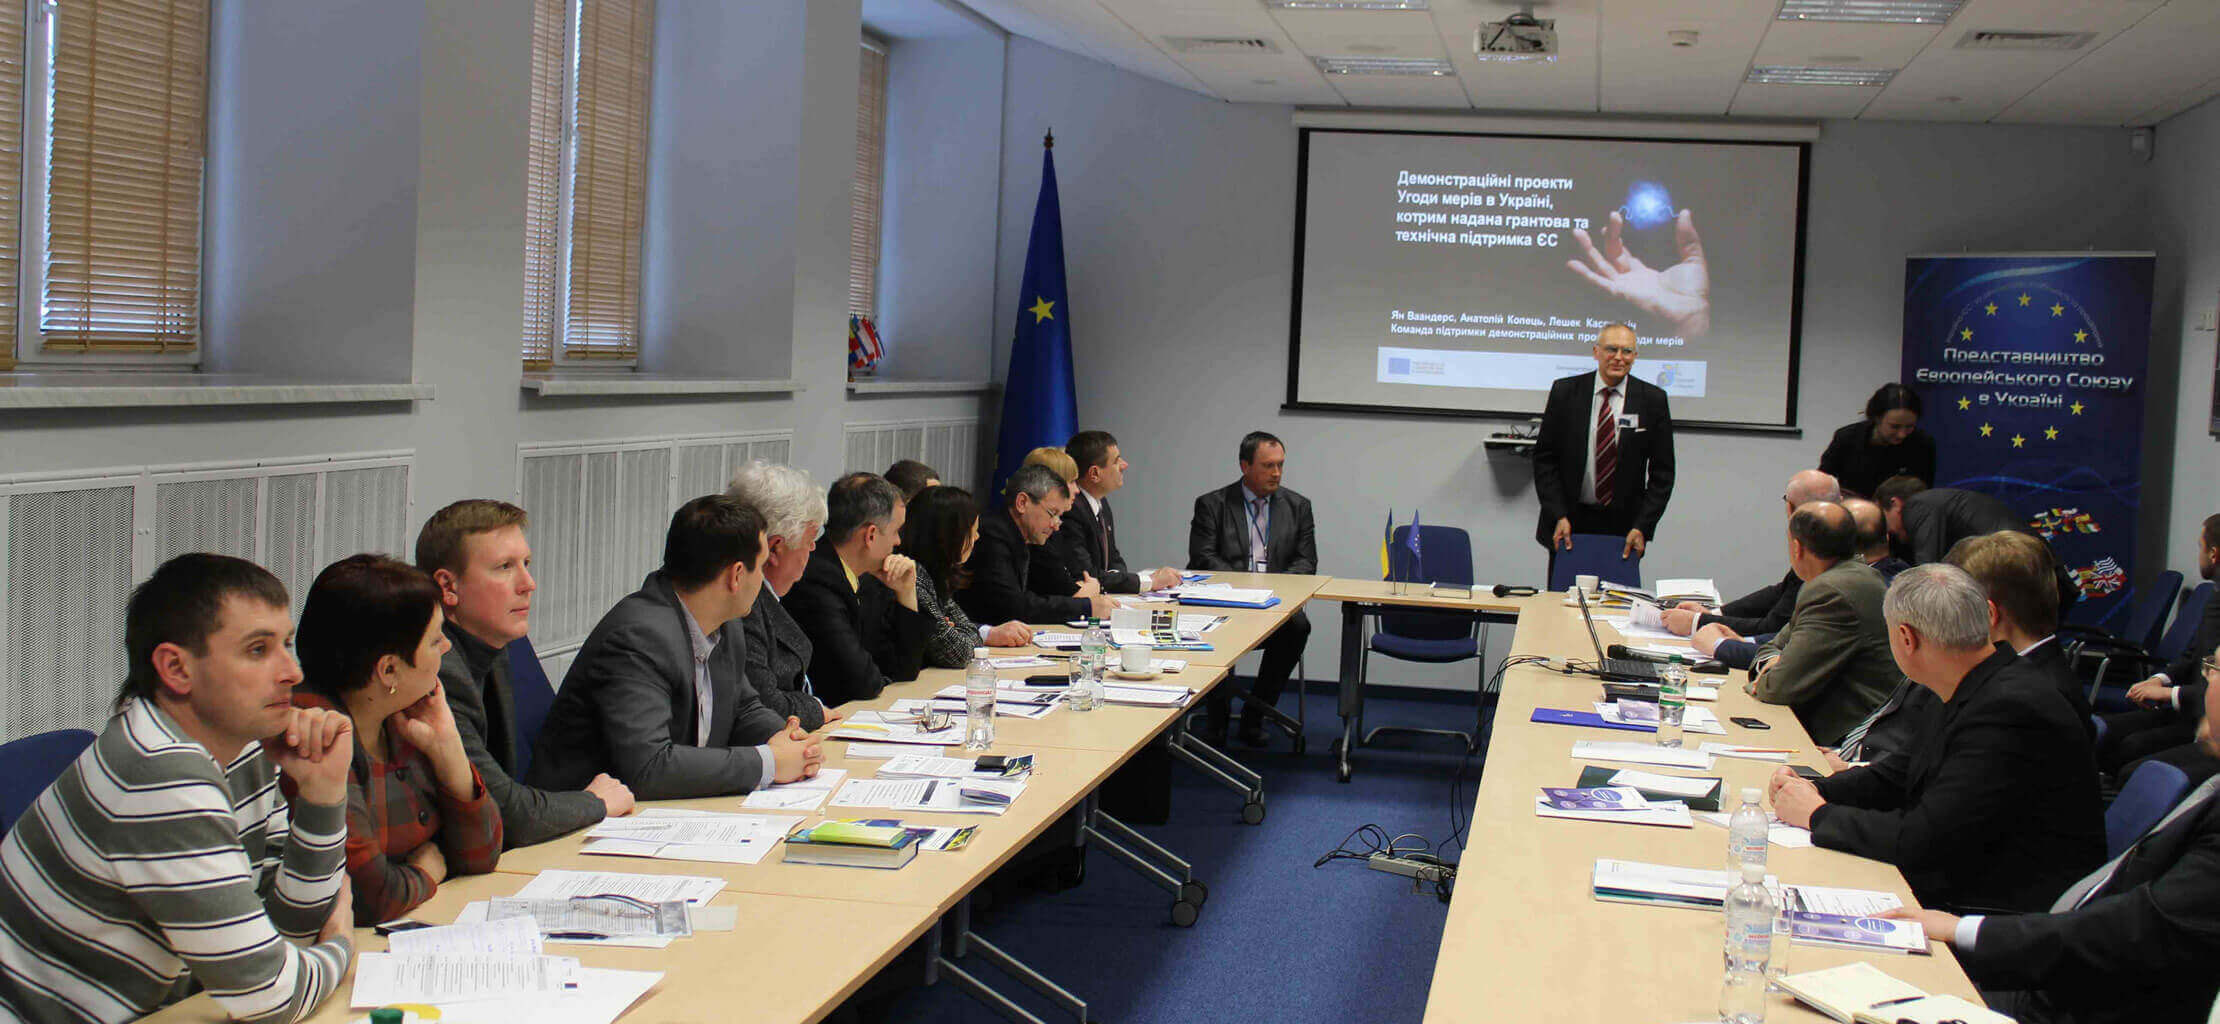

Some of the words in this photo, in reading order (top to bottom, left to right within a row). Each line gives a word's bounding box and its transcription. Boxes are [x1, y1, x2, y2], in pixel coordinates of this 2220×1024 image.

[1397, 171, 1512, 188] Демонстраційні
[1514, 177, 1573, 191] проекти
[1398, 190, 1438, 206] Угоди
[1442, 192, 1482, 208] мерів
[1486, 196, 1495, 206] в
[1499, 194, 1553, 210] Україні,
[1396, 211, 1446, 226] котрим
[1450, 215, 1503, 227] надана
[1505, 217, 1570, 229] грантова
[1573, 219, 1589, 229] та
[1395, 229, 1456, 244] технічна
[1459, 231, 1532, 248] підтримка
[1536, 233, 1558, 247] ЄС
[1391, 310, 1405, 320] Ян
[1391, 324, 1433, 335] Команда
[1436, 326, 1486, 338] підтримки
[1488, 329, 1574, 341] демонстраційних
[1655, 338, 1684, 348] мерів
[1943, 347, 2105, 366] Представництво
[1916, 368, 2061, 387] Європейського
[2066, 373, 2134, 391] Союзу
[1979, 394, 1990, 405] в
[1995, 391, 2064, 409] Україні
